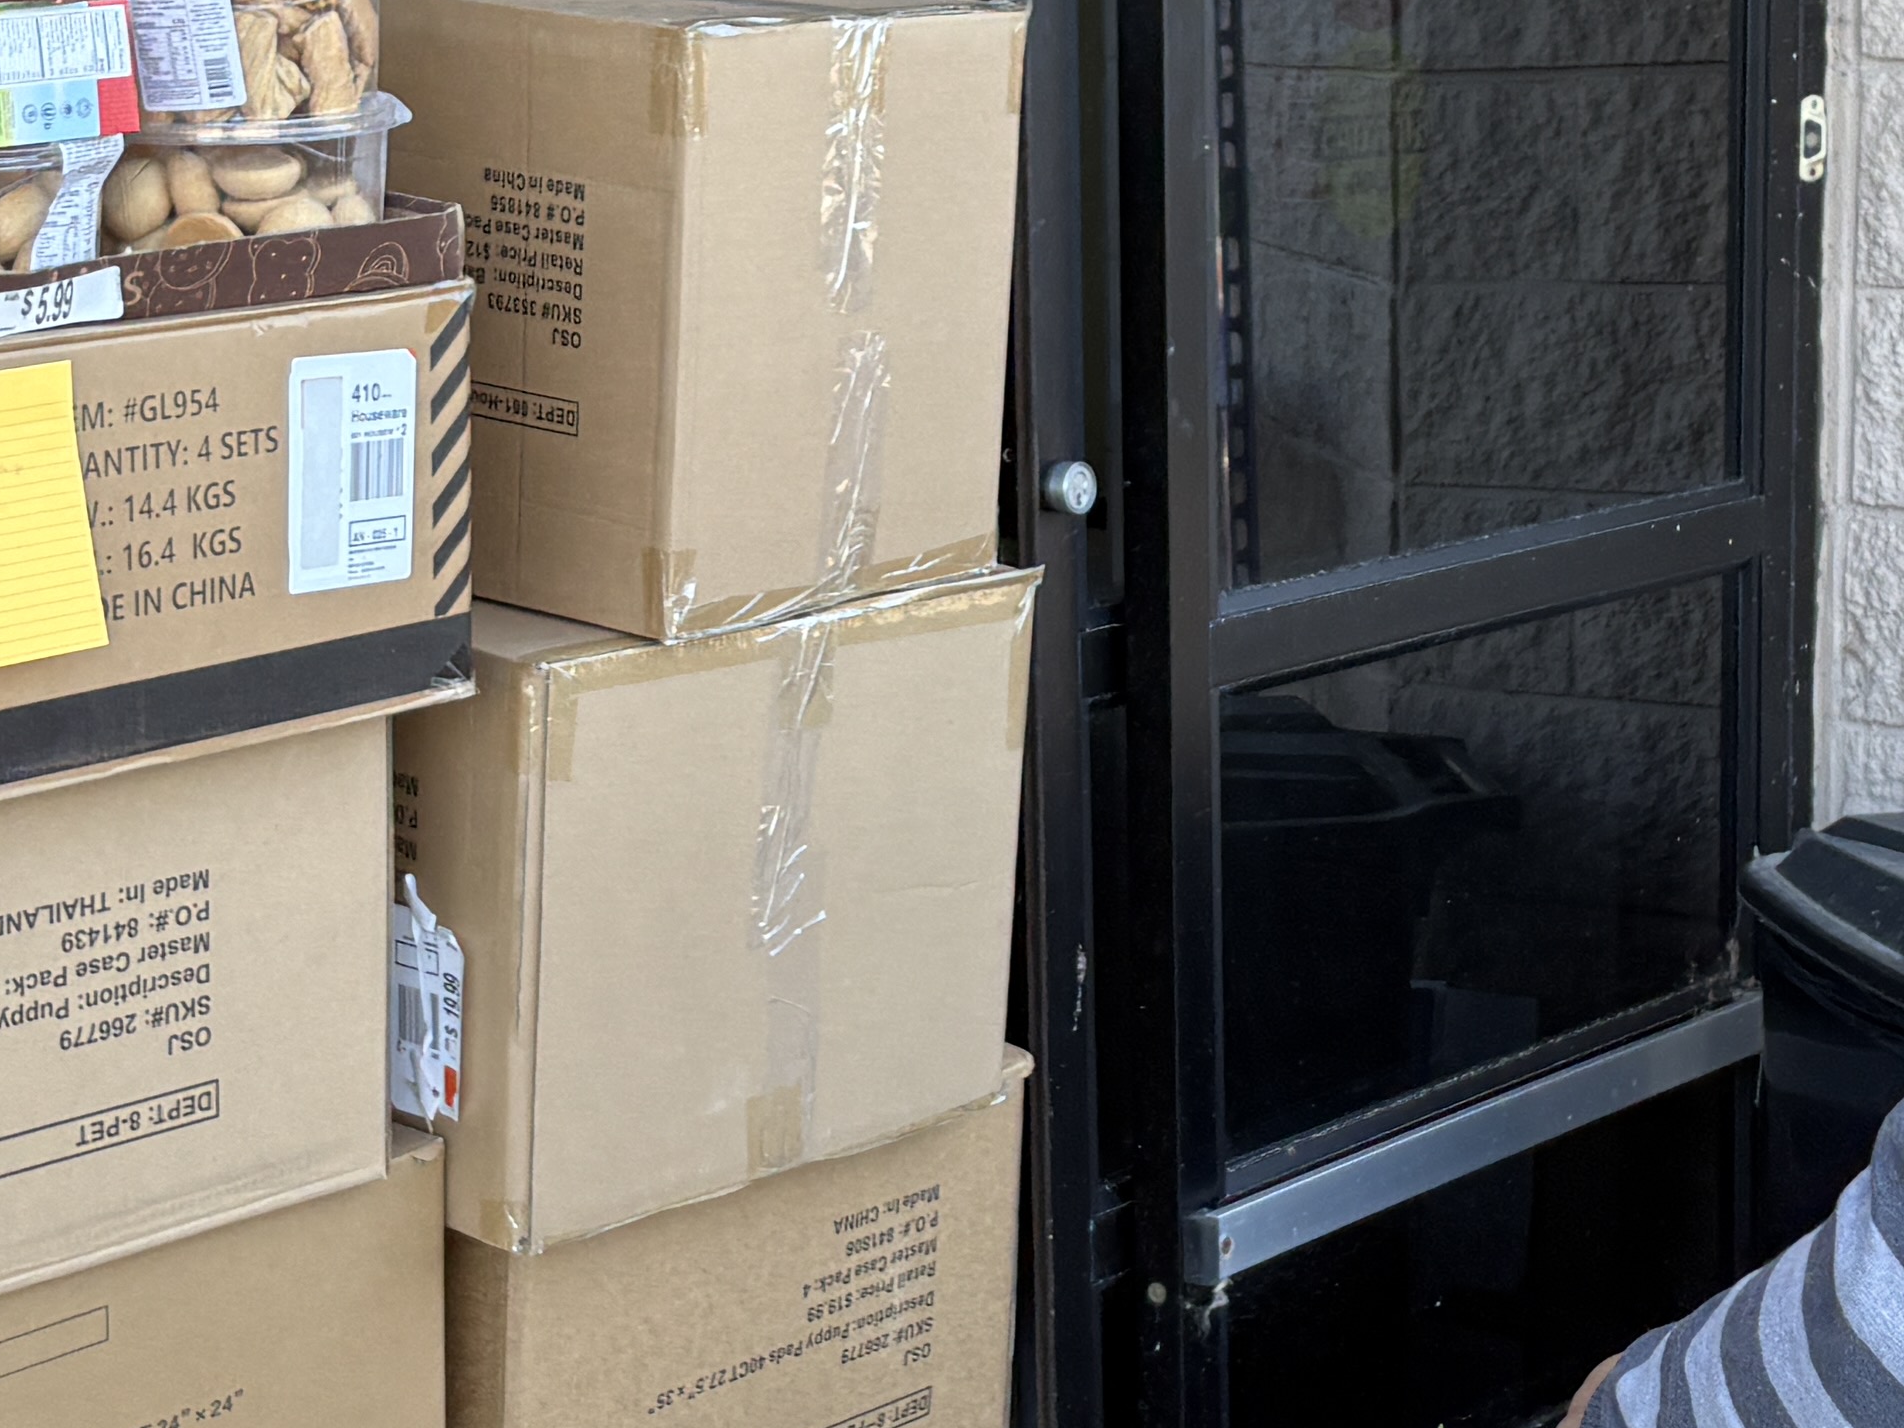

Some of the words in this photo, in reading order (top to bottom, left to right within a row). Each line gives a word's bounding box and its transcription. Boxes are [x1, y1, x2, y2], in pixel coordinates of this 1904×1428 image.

[484, 167, 526, 192] China
[528, 176, 543, 193] in
[546, 177, 585, 202] Made
[465, 213, 492, 234] Pac
[496, 220, 530, 242] Case
[535, 226, 584, 251] Master
[494, 244, 537, 266] Price:
[541, 252, 583, 275] Retail
[494, 267, 582, 300] Description:
[35, 278, 74, 325] 5.99
[542, 302, 582, 325] SKU#
[552, 328, 582, 349] OSJ
[123, 387, 220, 423] #GL954
[533, 402, 575, 426] DEPT:
[85, 439, 188, 480] ANTITY:
[197, 435, 212, 462] 4
[221, 425, 278, 460] SETS
[124, 489, 177, 522] 14.4
[186, 480, 236, 513] KGS
[123, 537, 176, 571] 16.4
[193, 526, 242, 559] KGS
[135, 586, 162, 616] IN
[172, 572, 255, 610] CHINA
[118, 883, 145, 906] In:
[152, 868, 210, 898] Made
[149, 900, 210, 932] P.O.#:
[60, 918, 138, 954] 841439
[137, 932, 210, 964] Master
[75, 951, 130, 978] Case
[4, 966, 68, 996] Pack:
[78, 963, 210, 1010] Description:
[443, 971, 460, 1016] 19.99
[144, 994, 211, 1028] SKU#:
[59, 1012, 137, 1050] 266779
[167, 1026, 212, 1056] OSJ
[149, 1090, 212, 1125] DEPT:
[75, 1110, 141, 1148] 8-PET
[882, 1198, 900, 1215] In:
[902, 1184, 940, 1209] Made
[833, 1206, 879, 1235] CHINA
[890, 1236, 937, 1266] Master
[813, 1267, 851, 1293] Pack:
[854, 1255, 887, 1279] Case
[897, 1261, 936, 1290] Retail
[802, 1283, 812, 1298] 4
[855, 1275, 894, 1301] Price:
[807, 1292, 853, 1323] $19.99
[853, 1290, 935, 1330] Description:
[805, 1320, 851, 1350] Puppy
[768, 1342, 804, 1364] Pads
[903, 1343, 931, 1367] OSJ
[728, 1356, 766, 1383] 40CT
[888, 1394, 928, 1422] DEPT:
